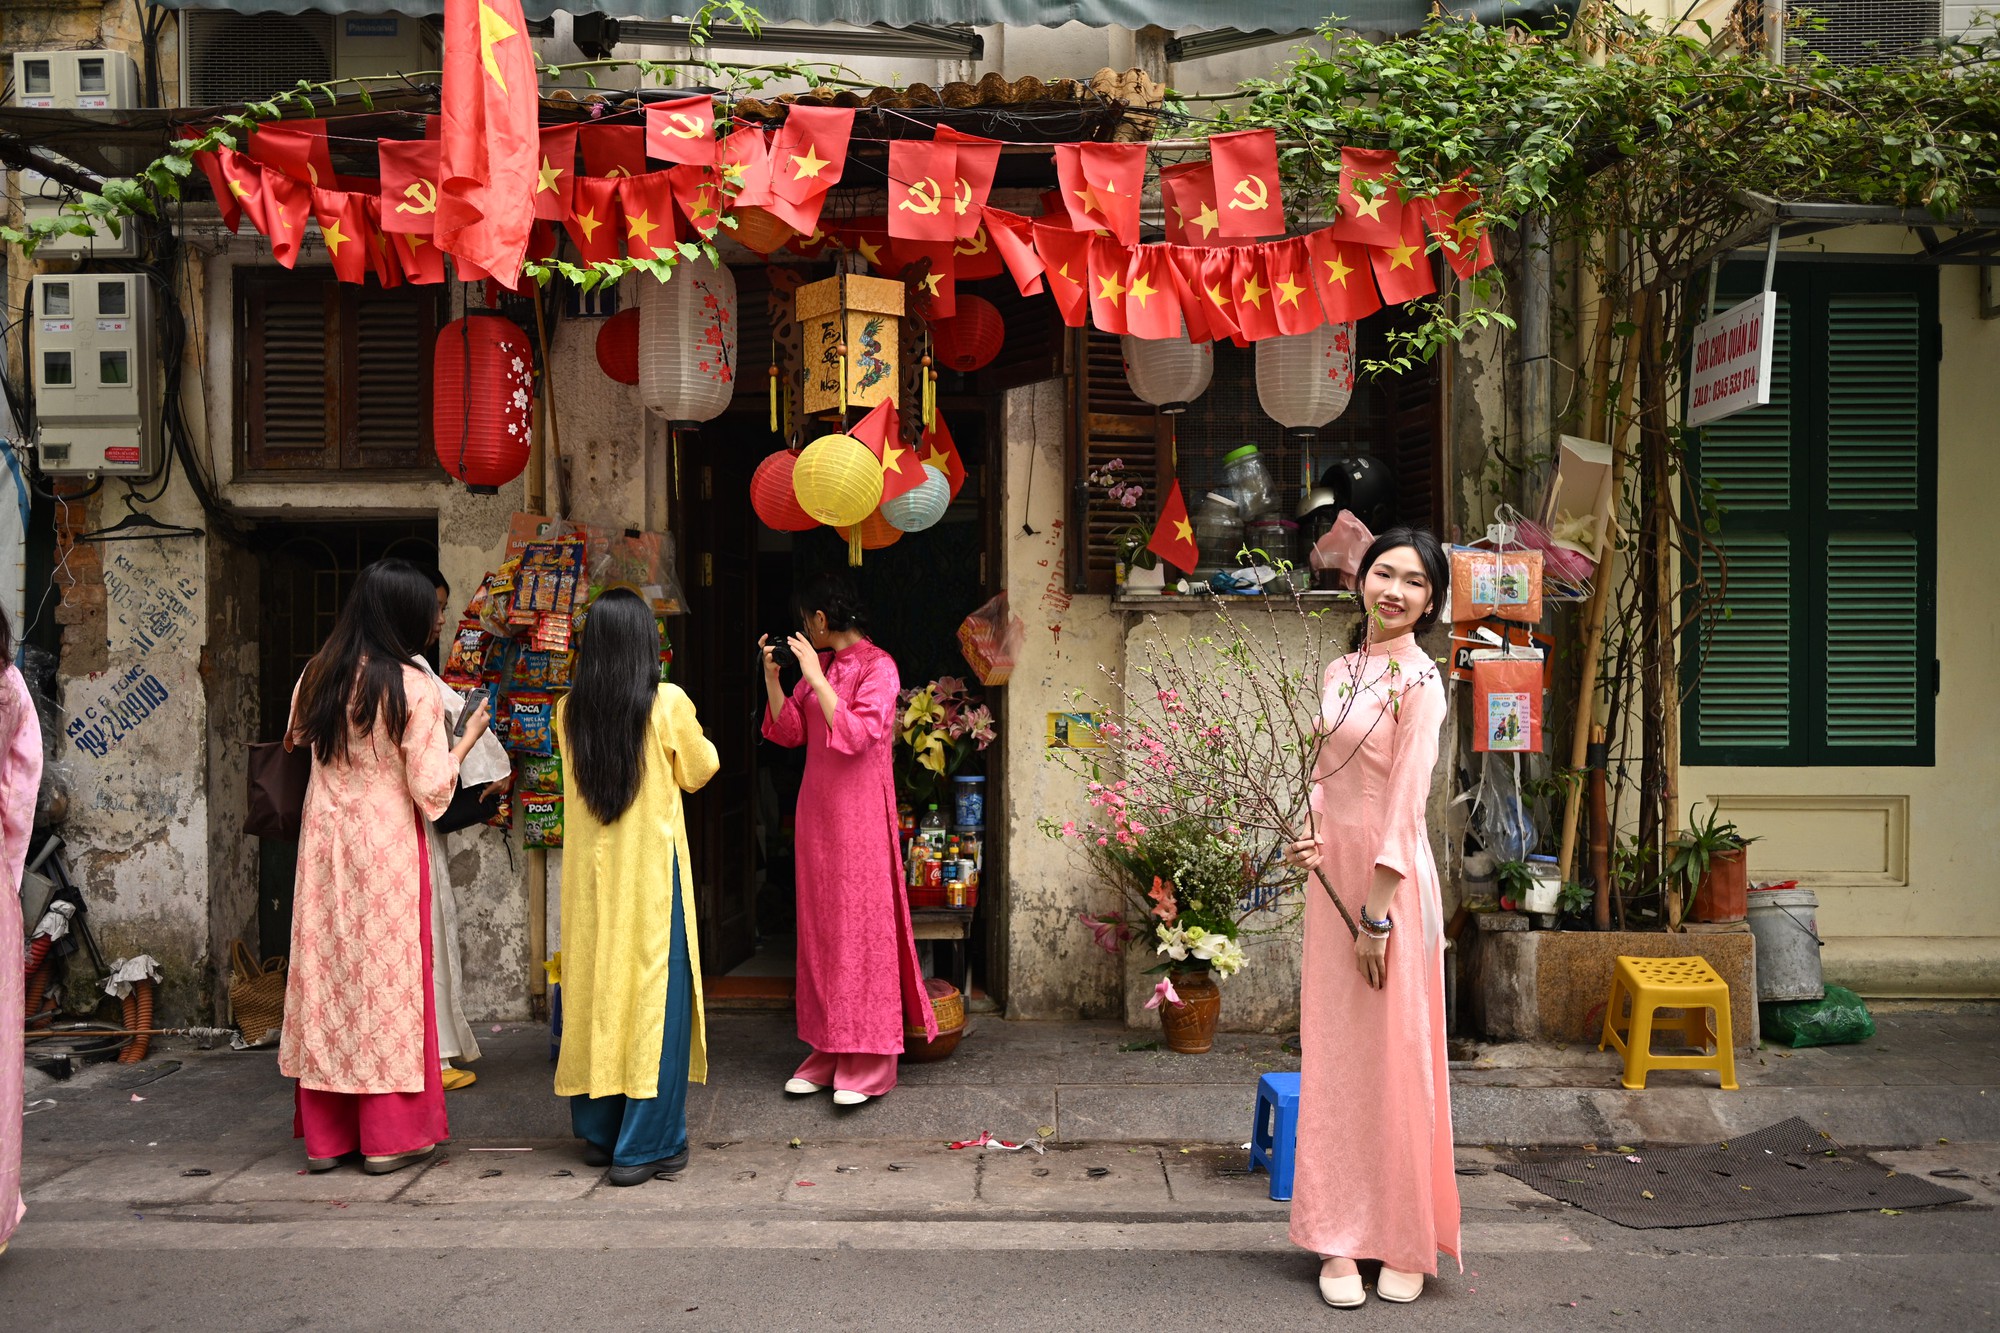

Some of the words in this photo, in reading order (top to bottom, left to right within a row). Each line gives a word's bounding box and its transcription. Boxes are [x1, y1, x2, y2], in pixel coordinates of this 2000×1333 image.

[348, 23, 395, 33] Panasonic
[1748, 313, 1759, 353] ÁO
[1713, 376, 1729, 402] 0345
[1729, 371, 1742, 396] 533
[1743, 365, 1756, 390] 814
[460, 628, 482, 638] POCA
[514, 703, 540, 714] POCA
[528, 804, 553, 814] POCA
